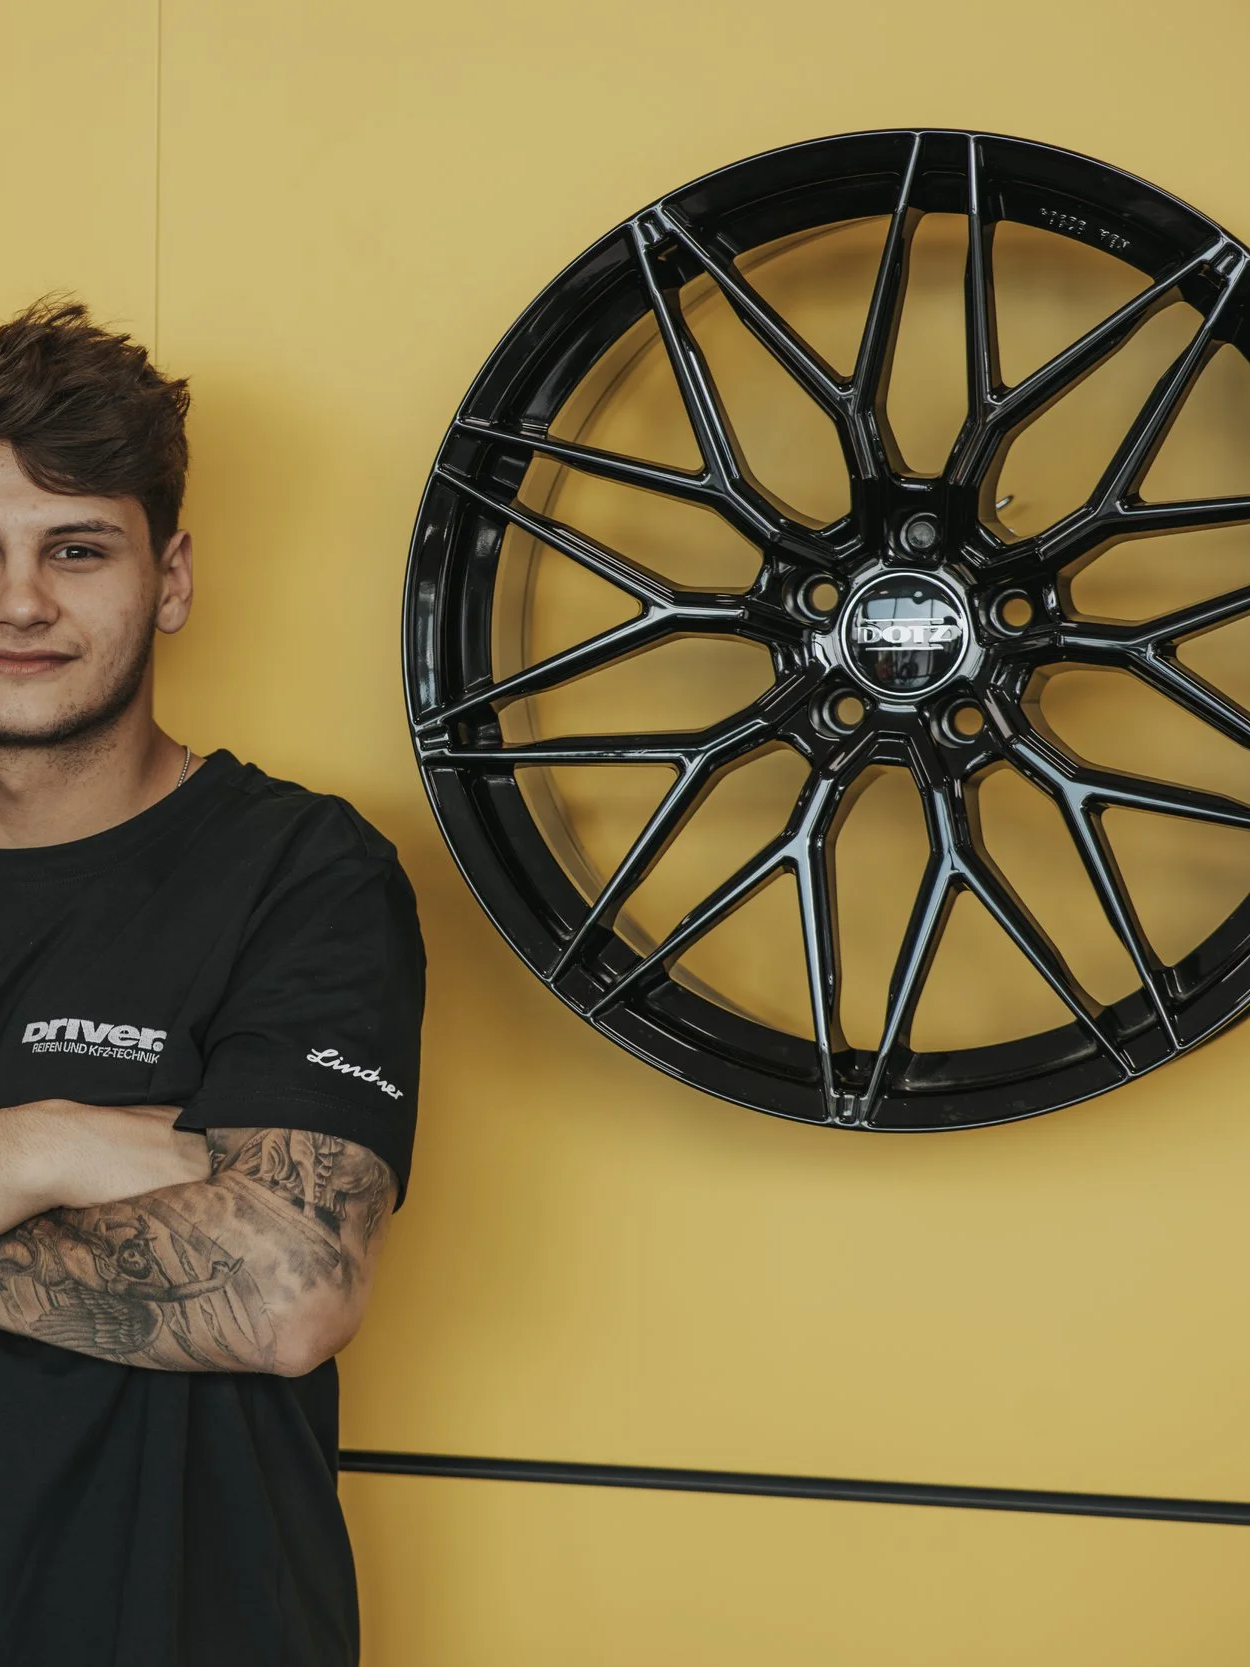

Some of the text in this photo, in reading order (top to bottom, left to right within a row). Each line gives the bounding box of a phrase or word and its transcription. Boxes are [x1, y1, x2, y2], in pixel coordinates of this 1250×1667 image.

[857, 624, 963, 645] DOTZ
[32, 1041, 161, 1065] REIFEN UND KFZ-TECHNIK
[306, 1048, 404, 1100] Lindner
